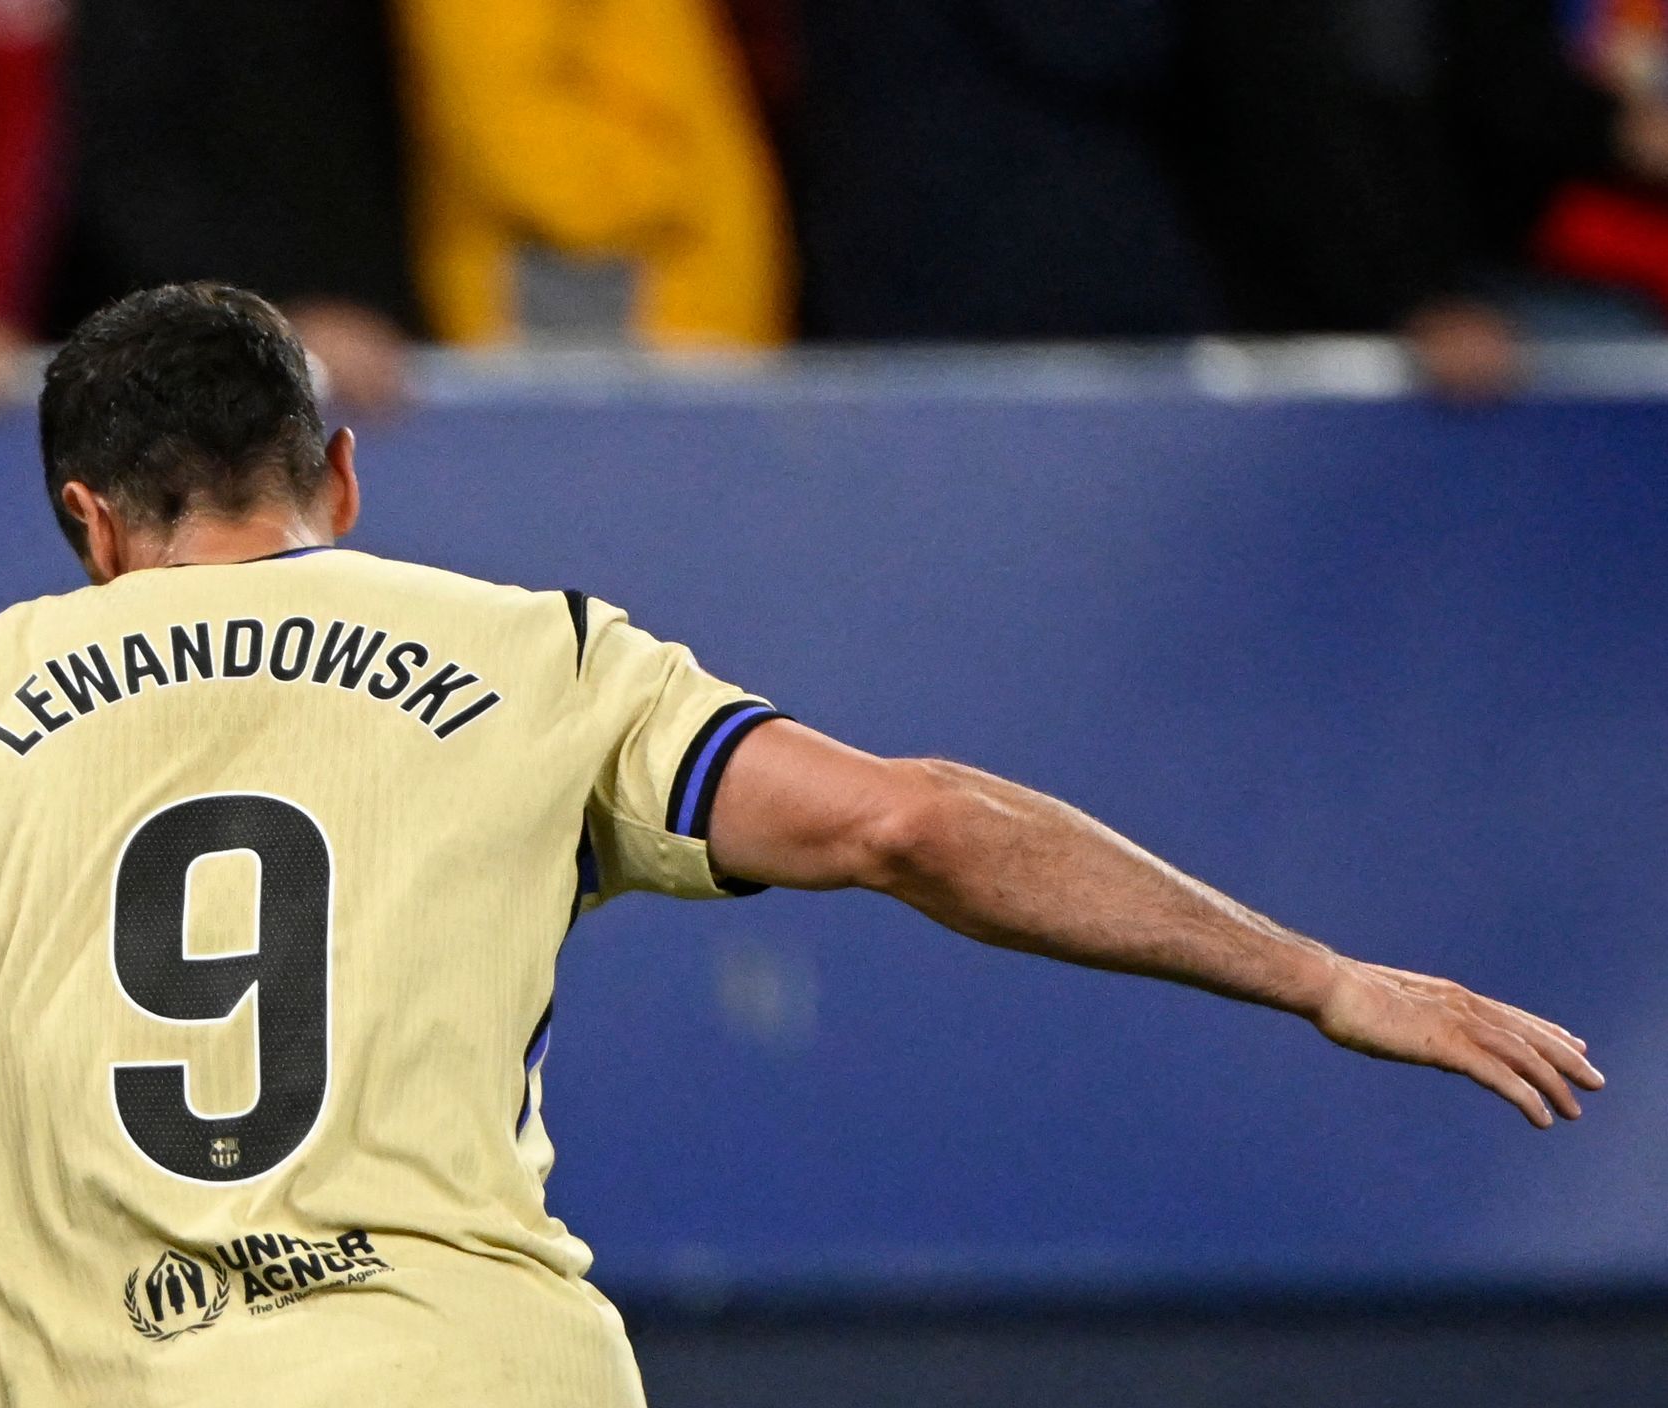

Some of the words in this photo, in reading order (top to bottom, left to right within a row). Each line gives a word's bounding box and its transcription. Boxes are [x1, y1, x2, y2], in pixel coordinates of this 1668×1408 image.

[108, 789, 336, 1187] 9
[248, 1303, 274, 1316] The
[274, 1292, 296, 1309] UN
